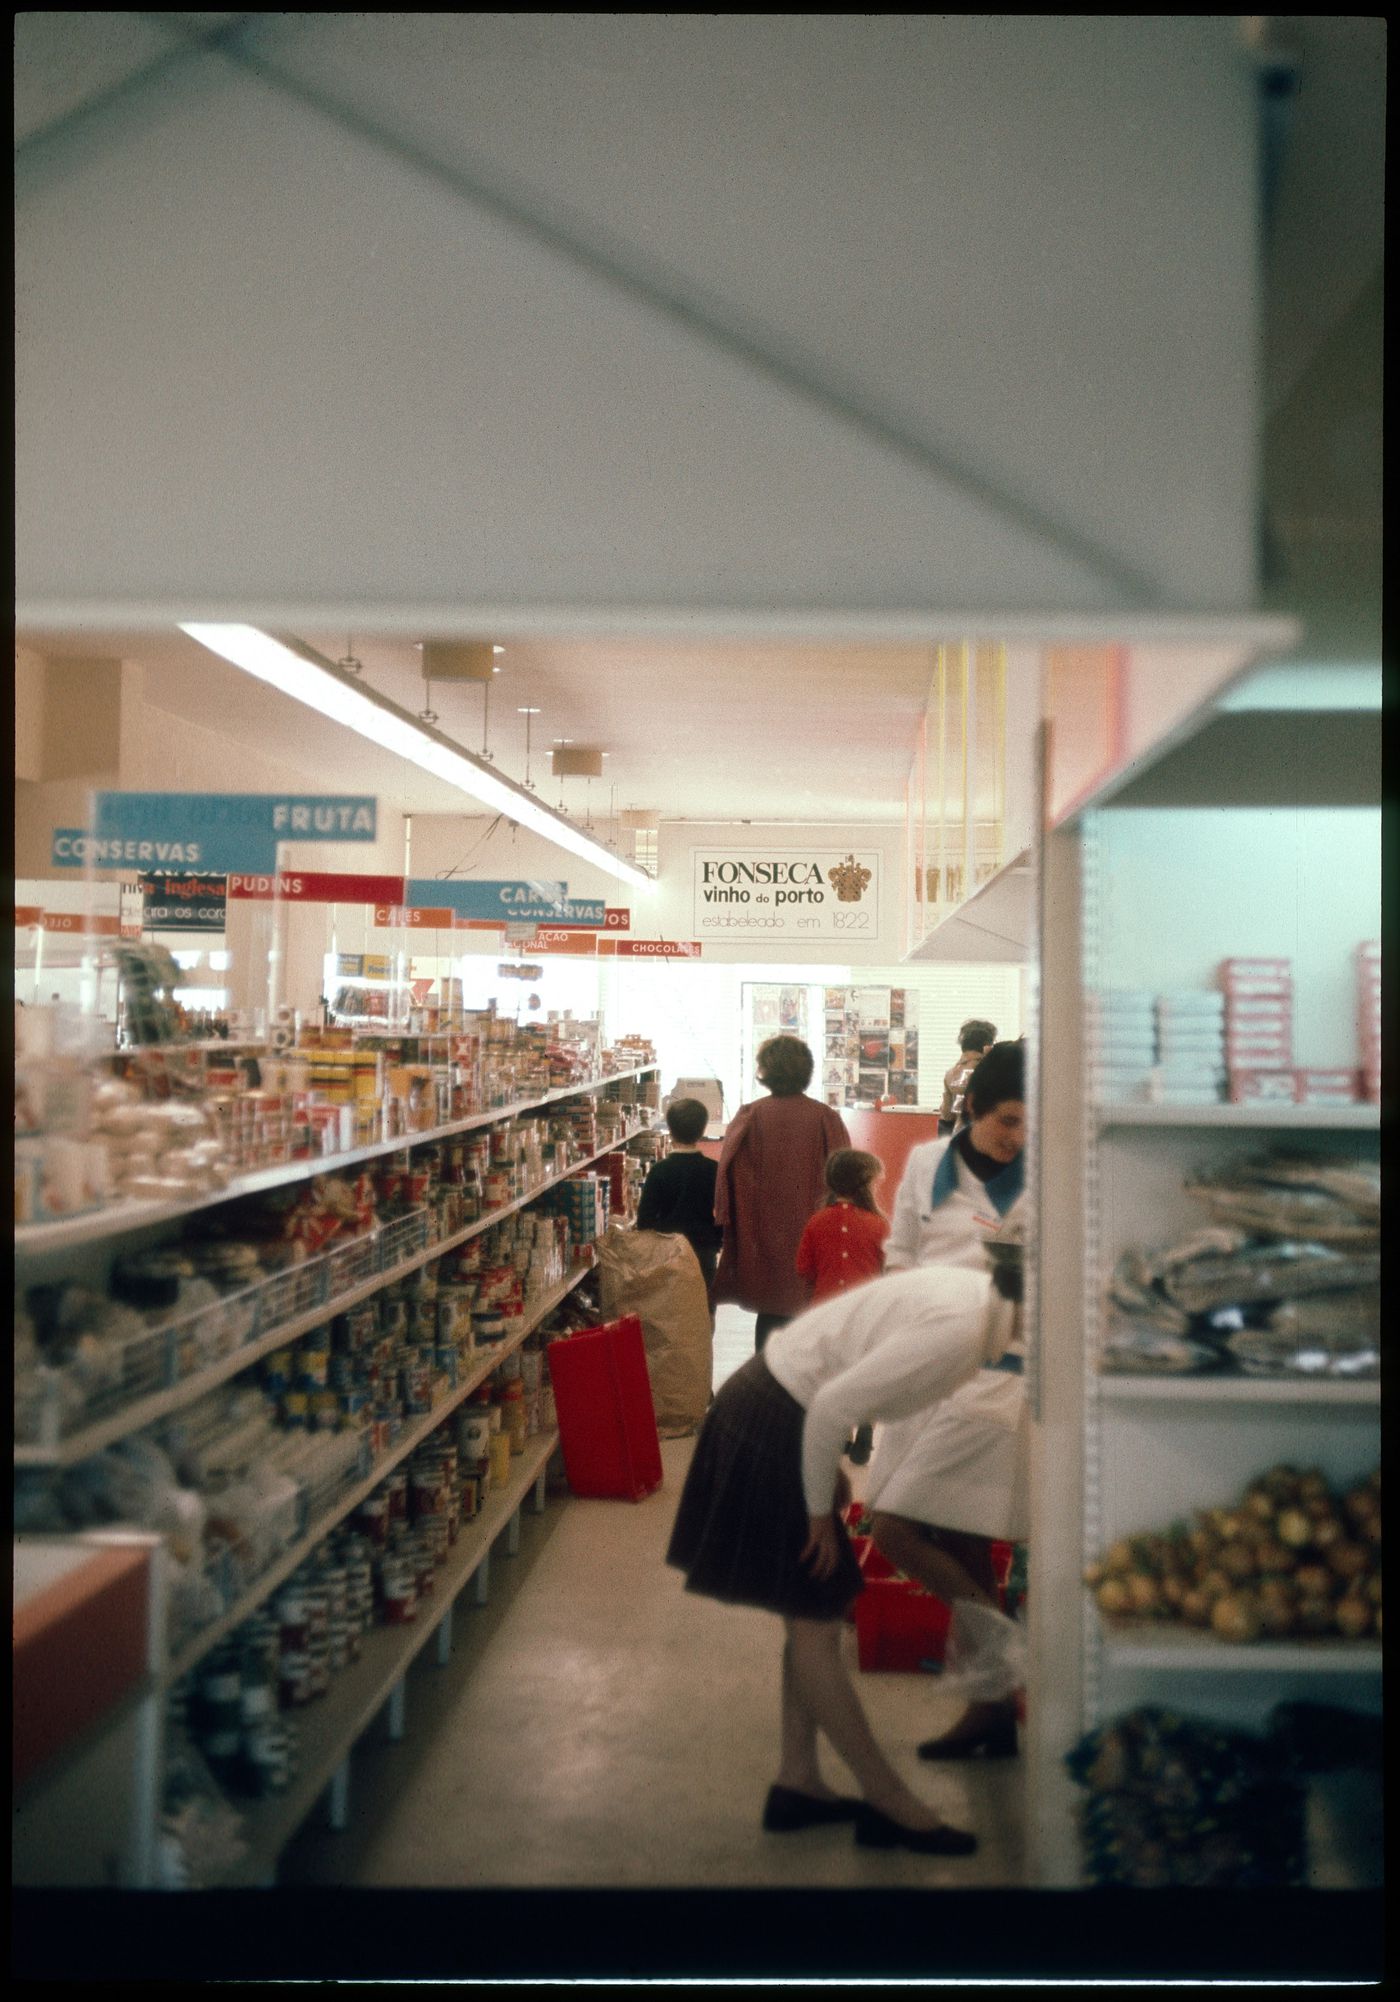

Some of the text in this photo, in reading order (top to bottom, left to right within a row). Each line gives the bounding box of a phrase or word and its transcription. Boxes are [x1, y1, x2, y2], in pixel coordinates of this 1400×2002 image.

[273, 804, 373, 832] FRUTA
[55, 837, 200, 862] CONSERVAS
[702, 861, 826, 885] FONSECA
[703, 886, 825, 906] vinho do porto
[174, 907, 192, 919] os
[797, 916, 821, 928] em
[833, 911, 870, 929] 1822
